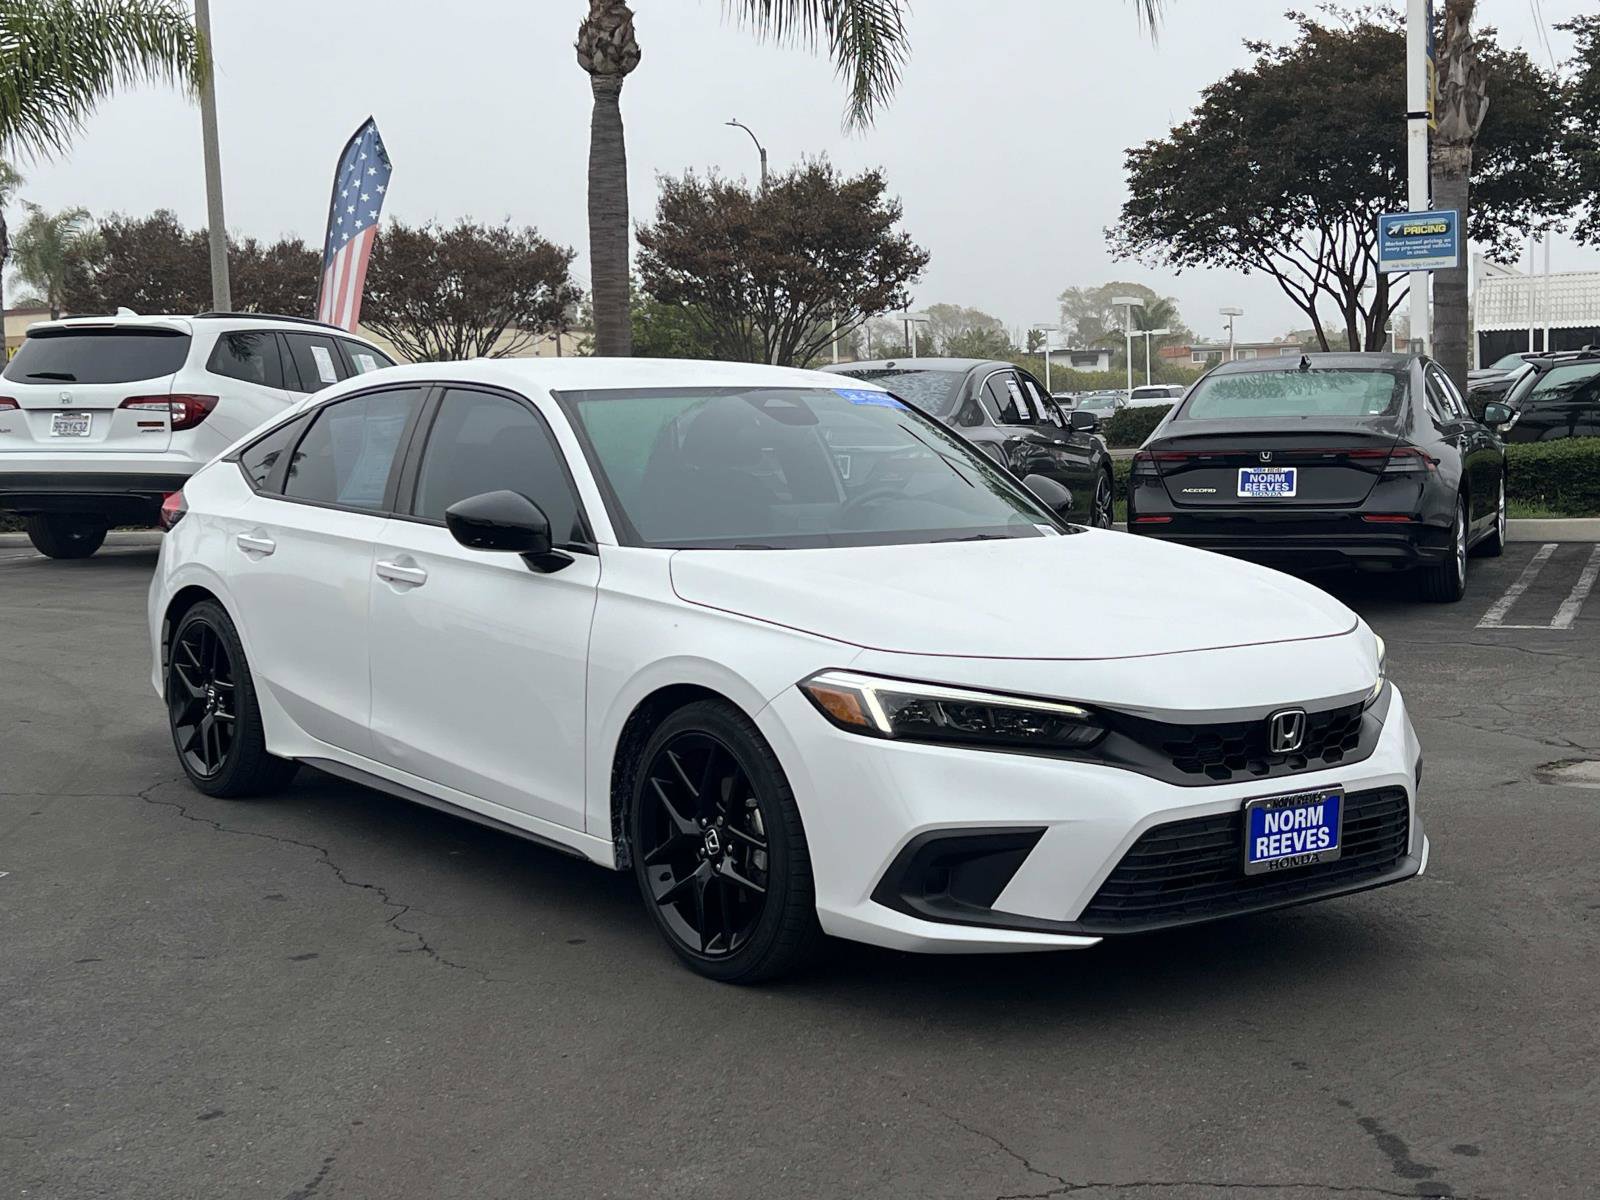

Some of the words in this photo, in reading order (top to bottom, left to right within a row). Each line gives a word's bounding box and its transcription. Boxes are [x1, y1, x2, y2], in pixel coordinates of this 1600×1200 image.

[1403, 224, 1447, 235] PRICING
[1249, 474, 1285, 482] NORM
[1244, 482, 1290, 491] REEVES
[1264, 805, 1324, 834] NORM
[1256, 826, 1330, 859] REEVES
[1268, 853, 1321, 870] HONDA
